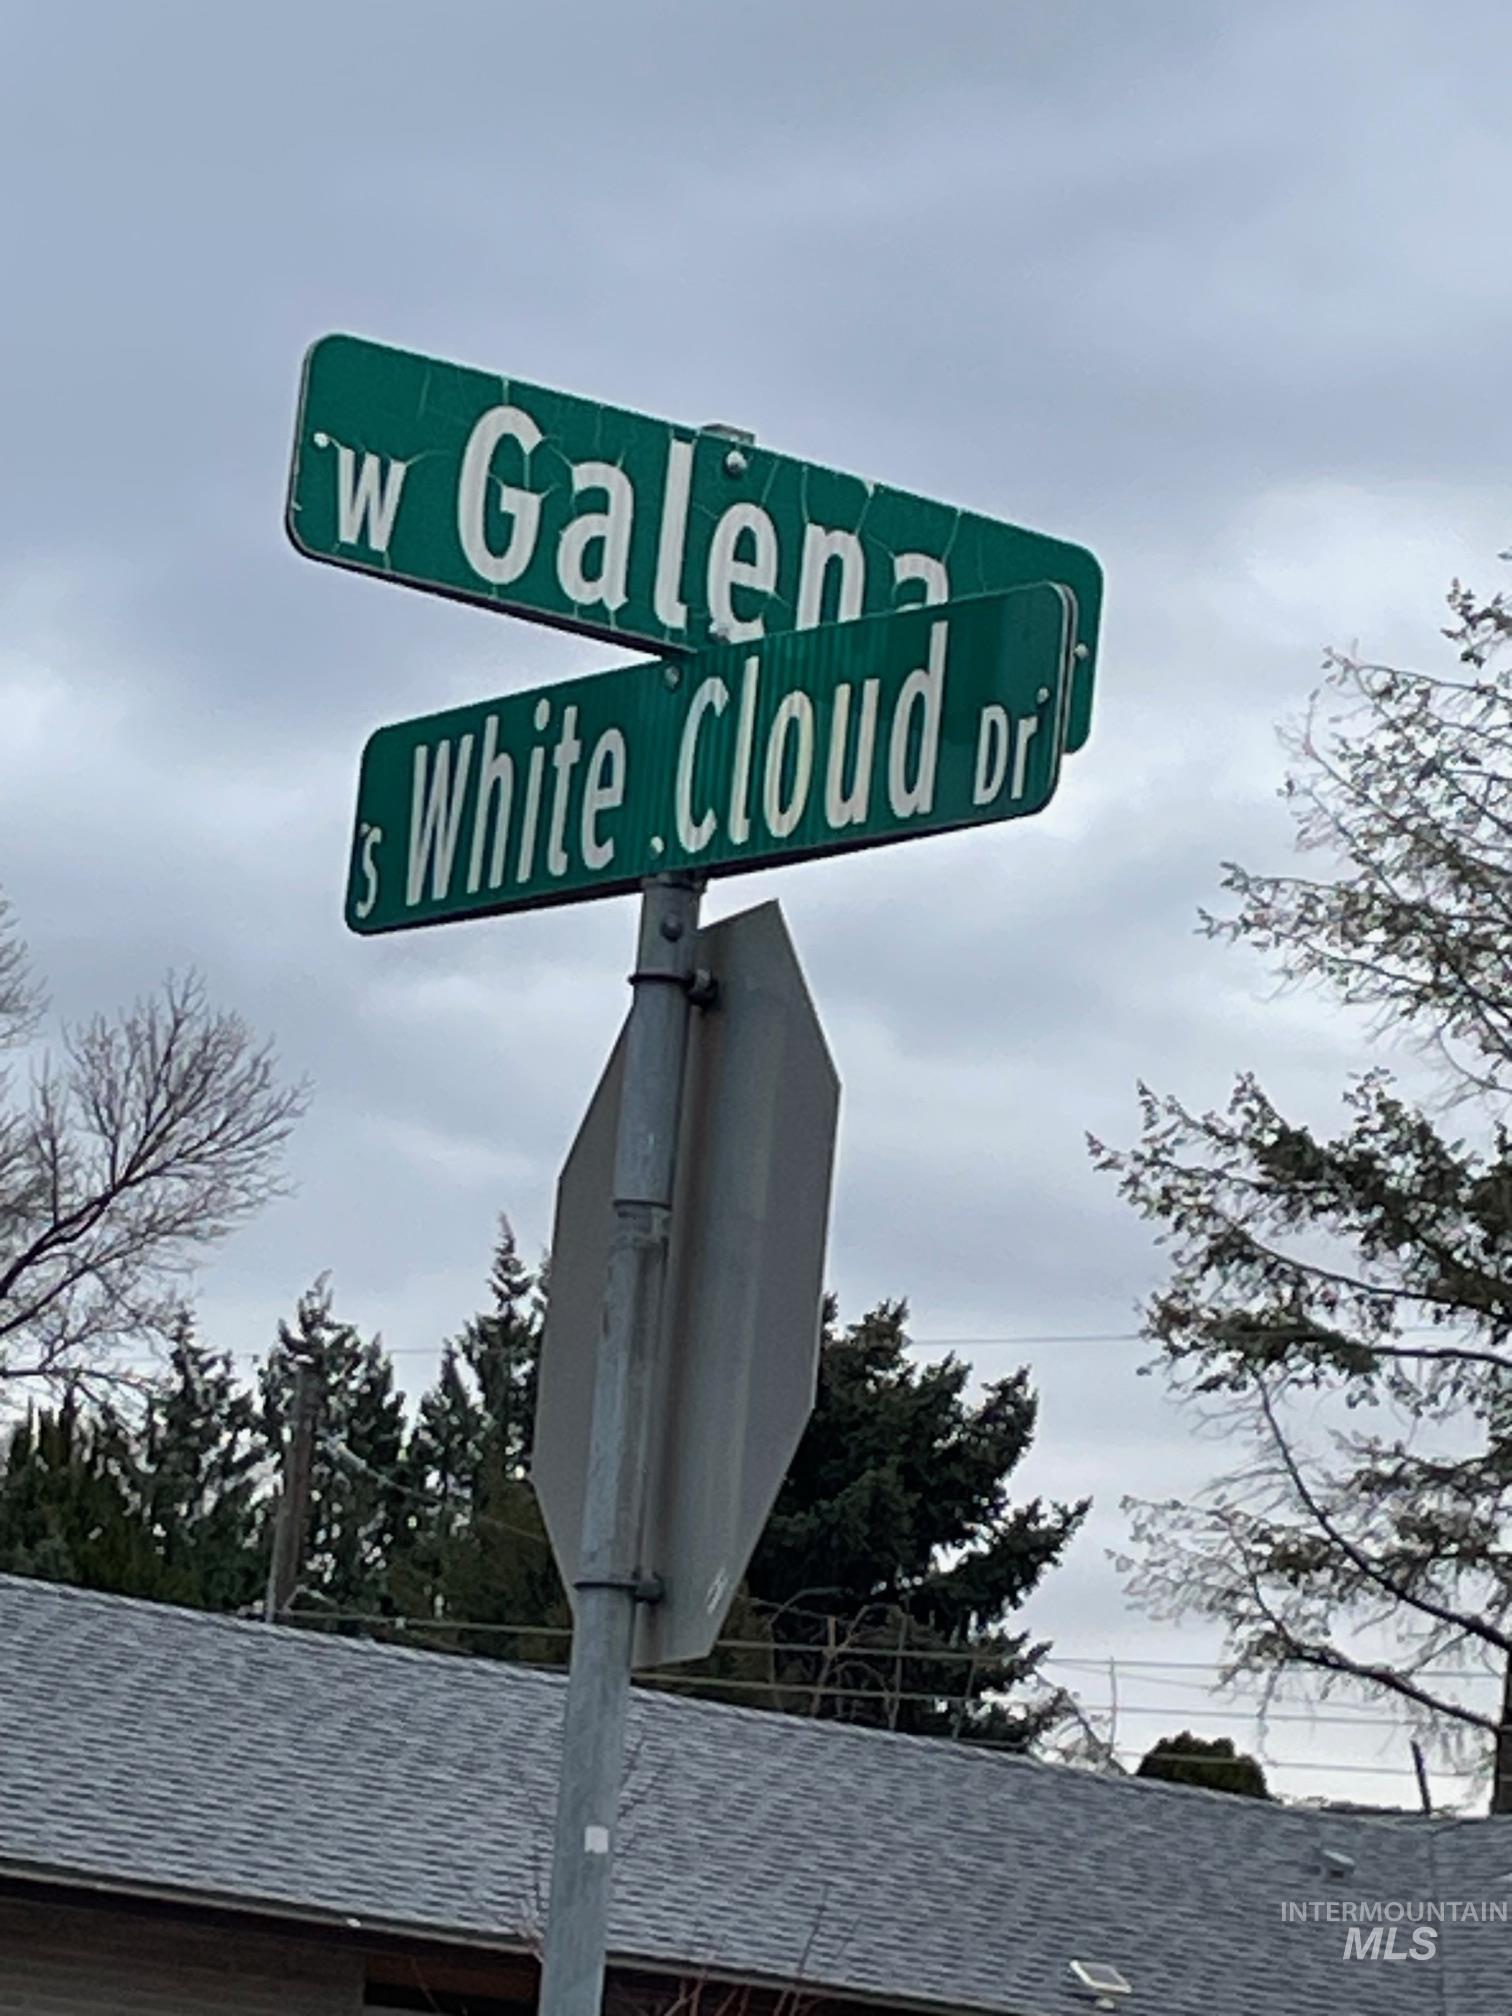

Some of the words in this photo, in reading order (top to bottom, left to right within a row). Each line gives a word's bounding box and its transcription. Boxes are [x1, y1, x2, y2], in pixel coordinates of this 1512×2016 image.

[337, 449, 407, 552] W
[356, 826, 382, 918] S
[406, 699, 626, 906] White
[675, 620, 948, 853] Cloud
[973, 704, 1038, 806] Dr
